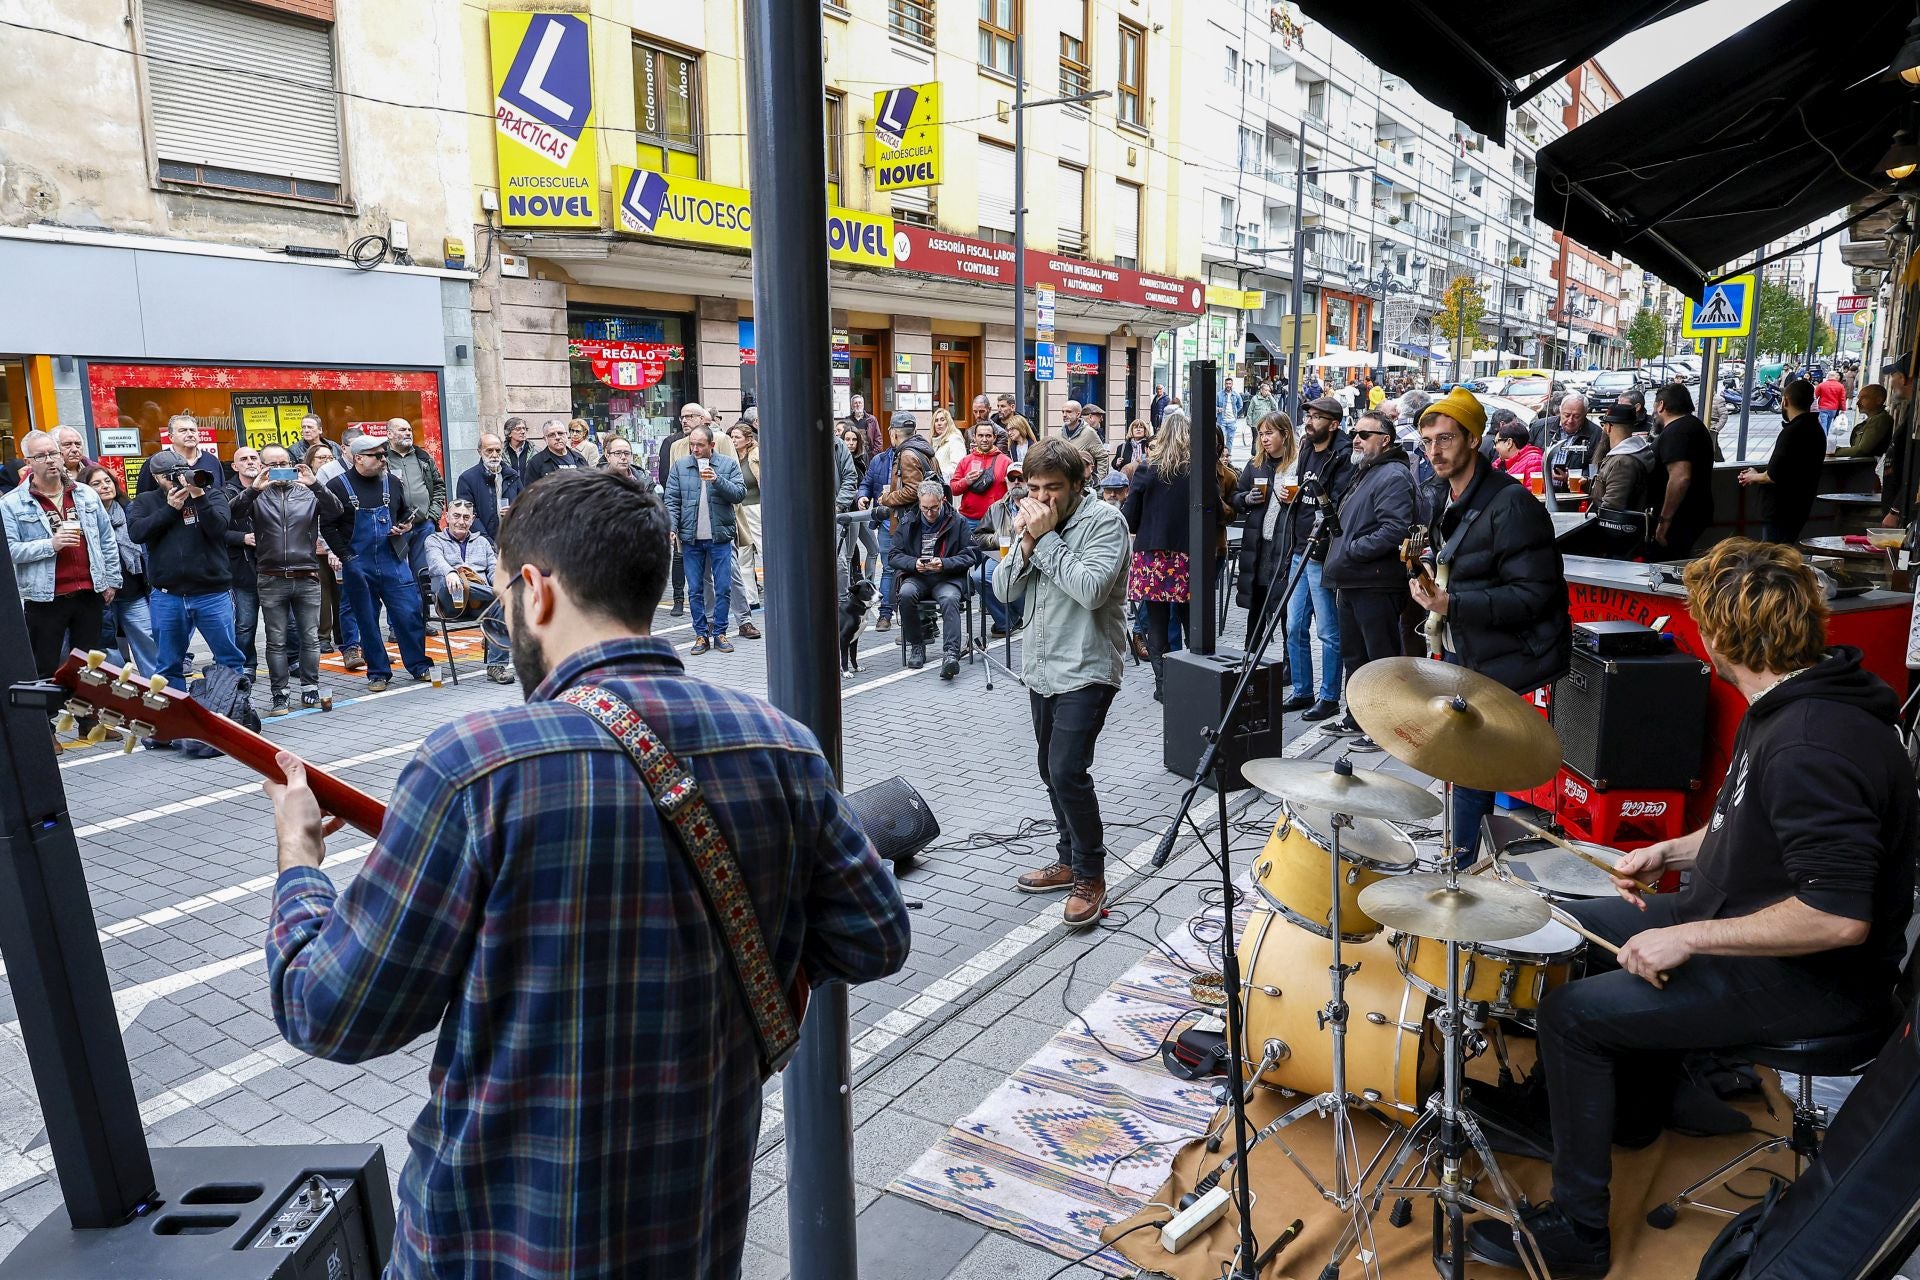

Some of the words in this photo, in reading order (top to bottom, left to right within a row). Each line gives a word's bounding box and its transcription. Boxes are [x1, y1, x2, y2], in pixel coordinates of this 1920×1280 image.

[679, 62, 689, 98] Moto
[645, 51, 656, 131] Ciclomotor
[497, 106, 568, 159] PRACTICAS
[875, 128, 900, 149] PRACTICAS
[880, 145, 933, 161] AUTOESCUELA
[508, 177, 589, 188] AUTOESCUELA
[879, 162, 935, 185] NOVEL
[508, 195, 592, 217] NOVEL
[621, 209, 652, 234] PRACTIC
[828, 217, 888, 257] OVEL
[928, 237, 966, 255] ASESORÍA
[966, 244, 993, 260] FISCAL,
[993, 250, 1016, 263] LABOR
[957, 260, 962, 270] Y
[963, 261, 999, 277] CONTABLE
[1049, 260, 1074, 273] GESTIÓN
[1074, 264, 1101, 278] INTEGRAL
[1101, 269, 1120, 282] PYMES
[1063, 278, 1068, 288] Y
[1067, 279, 1103, 293] AUTÓNOMOS
[1138, 277, 1178, 292] ADMINISTRACIÓN
[1177, 284, 1184, 293] DE
[1145, 292, 1178, 305] COMUNIDADES
[1854, 298, 1869, 308] CENT
[834, 328, 848, 336] Europa
[602, 348, 656, 361] REGALO
[1038, 355, 1054, 368] TAXI
[234, 396, 271, 405] OFERTA
[273, 395, 290, 404] DEL
[292, 393, 310, 404] DÍA
[1568, 670, 1587, 689] EICH
[1564, 777, 1588, 805] Coca-Cola
[1619, 801, 1667, 817] Coca-Cola
